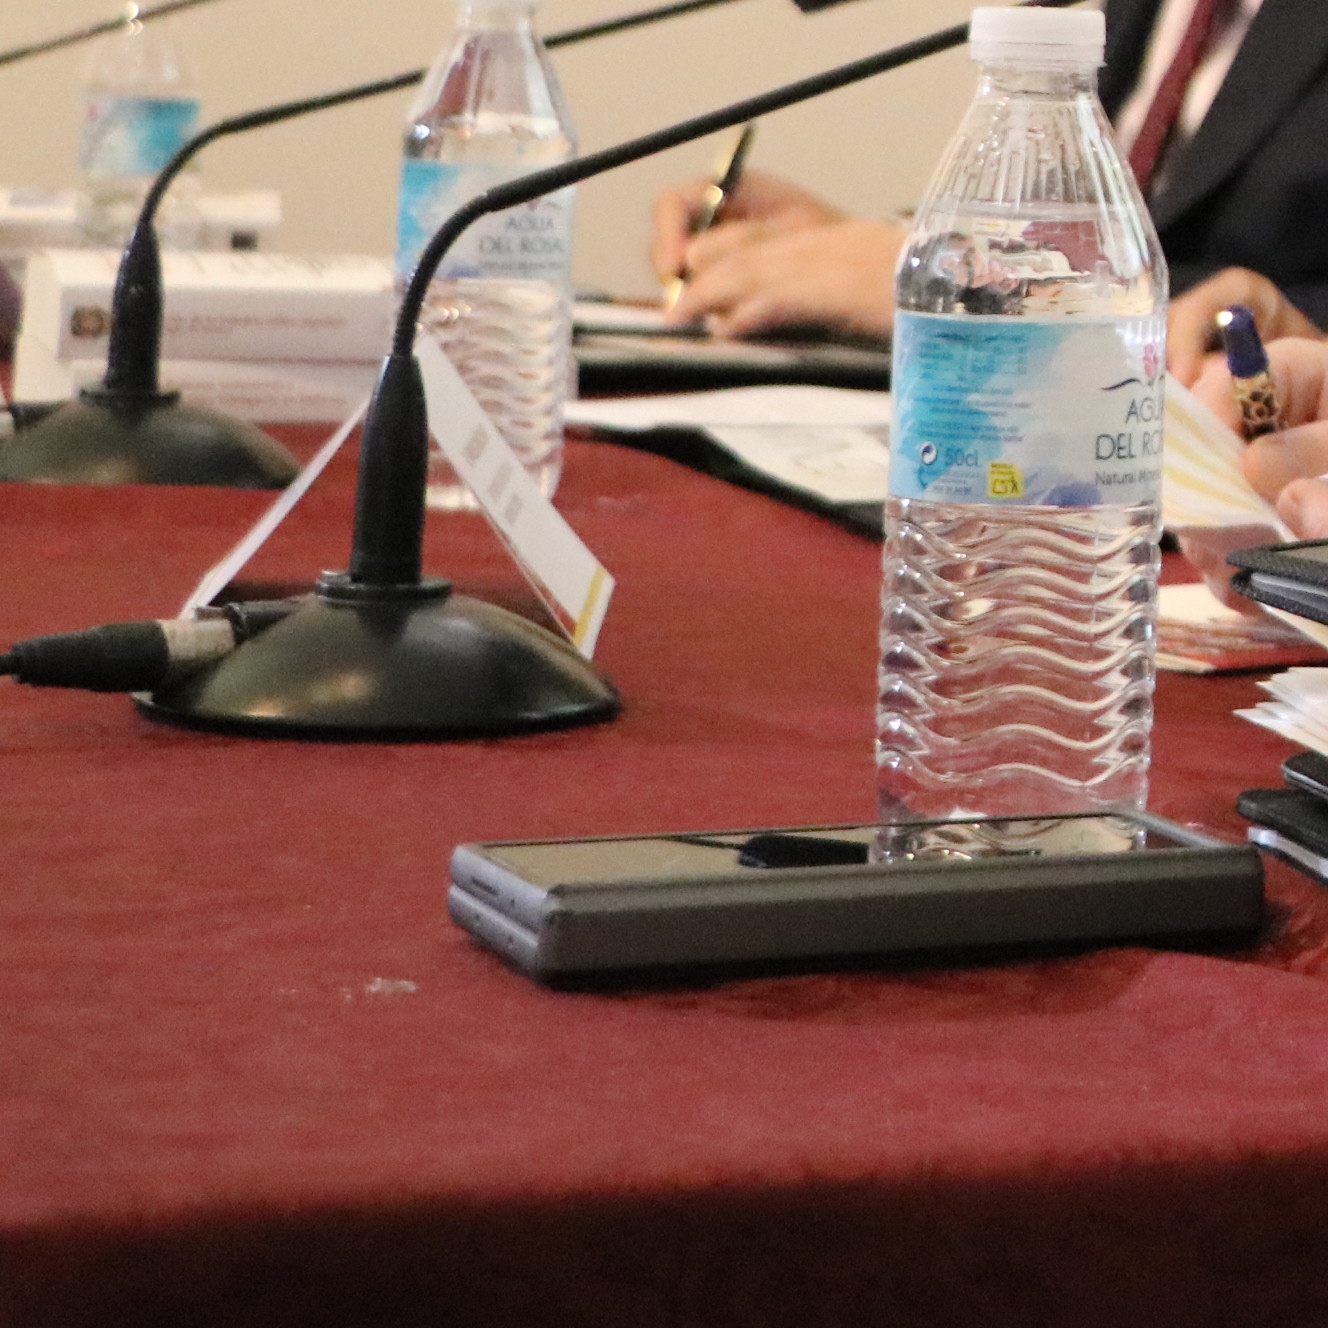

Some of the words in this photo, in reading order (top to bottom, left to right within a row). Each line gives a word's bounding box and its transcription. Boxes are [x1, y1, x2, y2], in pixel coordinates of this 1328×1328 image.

[1125, 396, 1164, 424] AGU
[1094, 432, 1136, 460] DEL
[1142, 430, 1164, 456] RO
